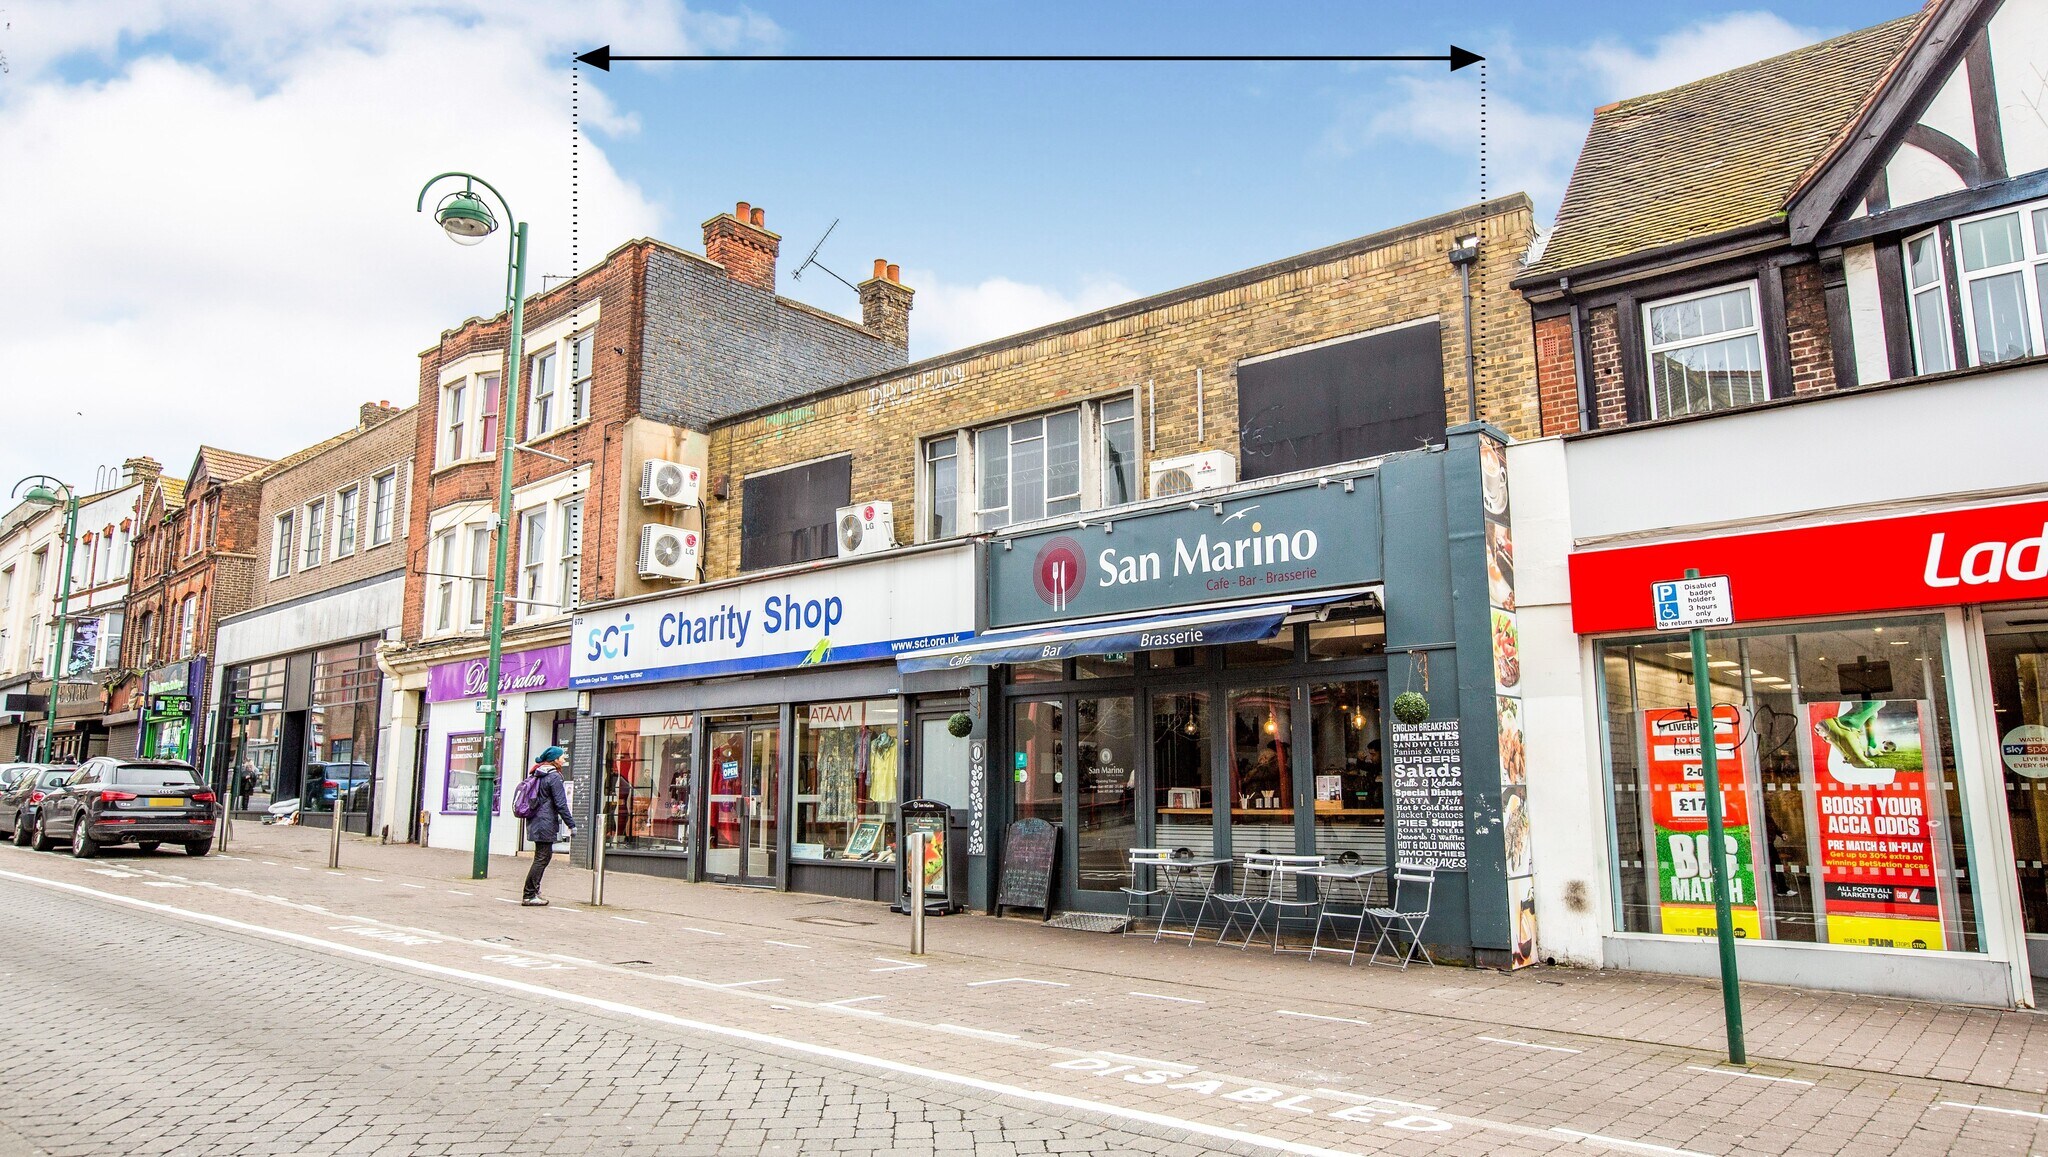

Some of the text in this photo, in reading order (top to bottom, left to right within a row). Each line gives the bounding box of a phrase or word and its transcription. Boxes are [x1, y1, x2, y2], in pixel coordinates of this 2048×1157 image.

[1099, 521, 1318, 587] San Marino
[1924, 521, 2048, 588] Lad
[1206, 567, 1317, 591] Cafe Bar Brasserie
[1684, 582, 1717, 590] Disabled
[659, 594, 843, 648] Charity Shop
[891, 634, 960, 651] www.sct.org.uk
[1140, 628, 1203, 647] Brasserie
[1042, 645, 1063, 657] Bar
[949, 655, 972, 667] Cafe
[512, 659, 546, 689] salon
[1392, 721, 1458, 732] ENGLISH BREAKFASTS
[1392, 731, 1459, 741] OMELETTES
[2006, 745, 2024, 754] sky
[1394, 755, 1460, 763] BURGERS
[724, 768, 738, 777] OPEN
[1088, 765, 1124, 774] San Marino
[1394, 763, 1461, 777] Salads
[1394, 778, 1418, 787] Grills
[1431, 778, 1462, 788] Kebabs
[1395, 788, 1463, 797] Special Dishes
[1437, 797, 1460, 805] Fish
[1821, 796, 1922, 816] BOOST YOUR
[1432, 819, 1464, 828] Soups
[1828, 816, 1920, 835] ACCA ODDS
[1397, 832, 1427, 840] Desserts
[1398, 841, 1465, 850] HOT & COLD DRINKS
[1828, 840, 1924, 853] PRE MATCH & IN-PLAY
[1424, 857, 1467, 868] SHAKES
[1826, 859, 1857, 867] winning
[1860, 860, 1903, 868] BetStation
[1670, 876, 1744, 903] MATH
[1852, 886, 1892, 894] FOOTBALL
[1697, 927, 1718, 936] FUN
[1868, 938, 1894, 947] FUN
[1049, 1057, 1454, 1132] DISABLED
